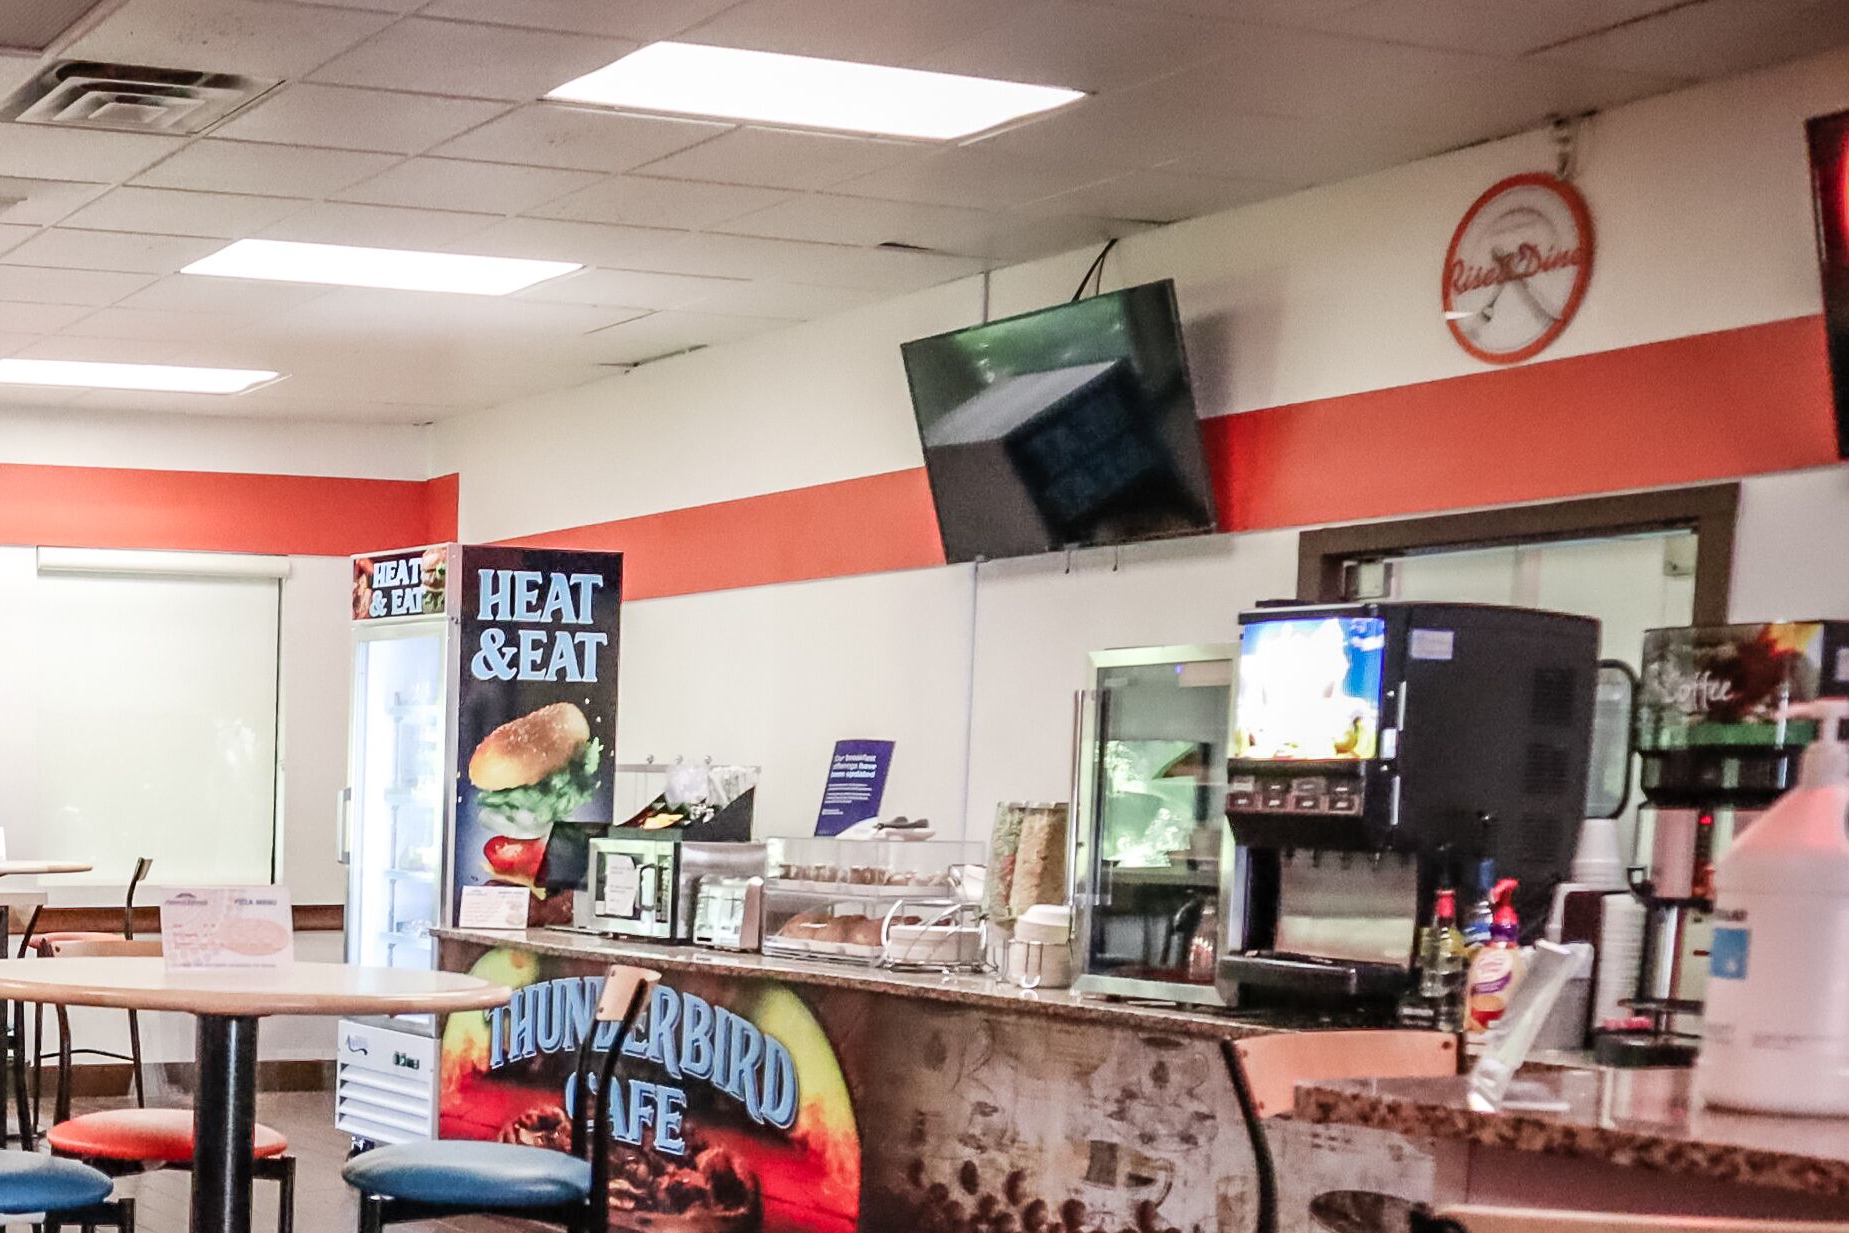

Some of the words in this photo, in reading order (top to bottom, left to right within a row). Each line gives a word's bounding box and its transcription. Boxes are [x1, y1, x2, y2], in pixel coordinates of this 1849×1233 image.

[372, 557, 422, 589] HEAT
[369, 590, 387, 617] &
[391, 588, 425, 616] EAT
[477, 568, 603, 624] HEAT
